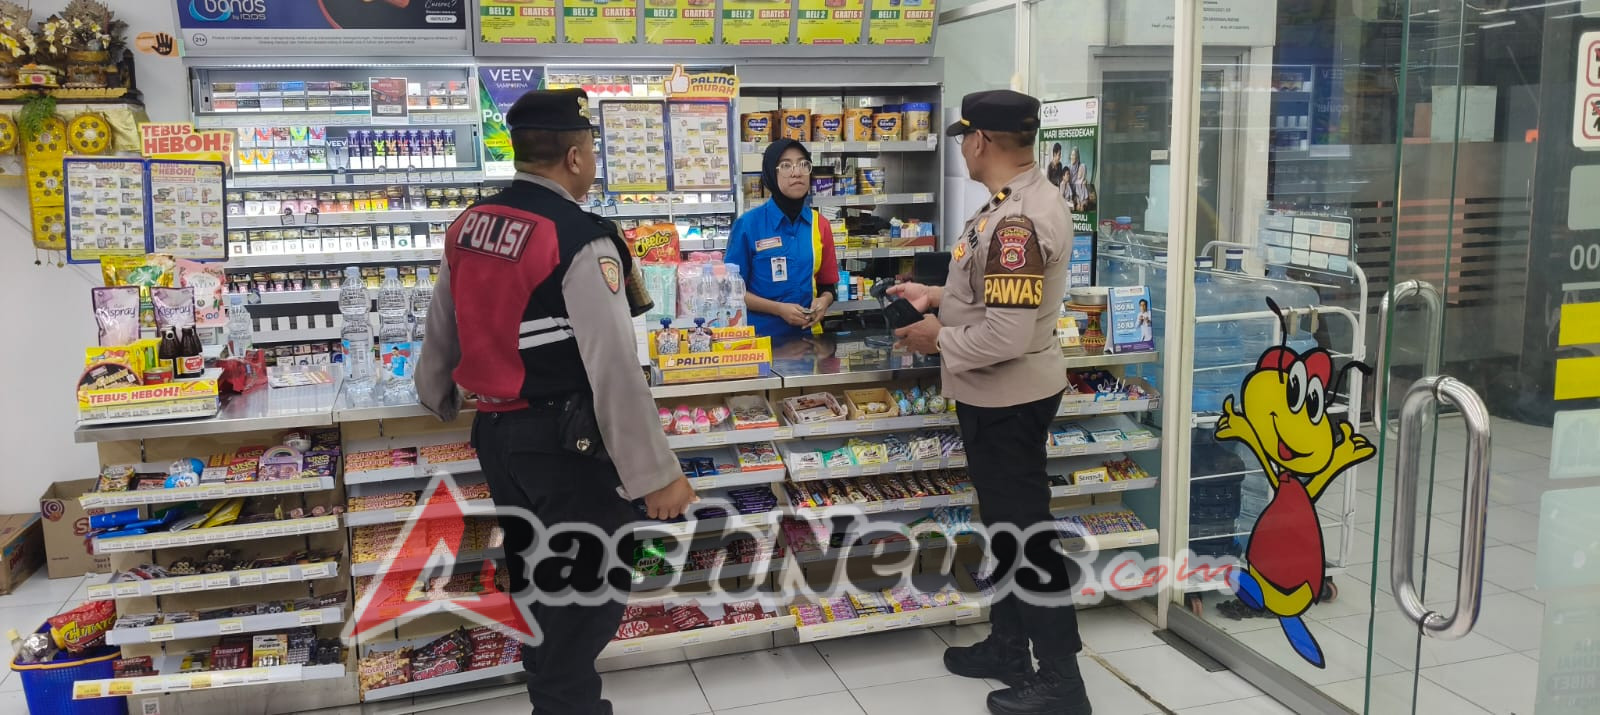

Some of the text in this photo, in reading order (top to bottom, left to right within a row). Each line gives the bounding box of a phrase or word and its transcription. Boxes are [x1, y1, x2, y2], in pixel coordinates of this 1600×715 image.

[489, 7, 504, 16] BELI
[523, 7, 548, 16] GRATIS
[573, 8, 588, 16] BELI
[605, 8, 630, 17] GRATIS
[654, 9, 668, 17] BELI
[684, 9, 708, 18] GRATIS
[731, 10, 746, 18] BELI
[761, 10, 784, 18] GRATIS
[806, 10, 820, 18] BELI
[834, 10, 858, 19] GRATIS
[878, 10, 892, 19] BELI
[906, 10, 929, 19] GRATIS
[489, 69, 534, 81] VEEV
[690, 76, 735, 86] PALING
[692, 84, 735, 95] MURAH
[142, 125, 190, 137] TEBUS
[1044, 128, 1094, 139] MARI BERSEDEKAH
[144, 132, 231, 154] HEBOH!
[457, 212, 530, 258] POLISI
[634, 231, 672, 258] Cheetos
[984, 278, 1043, 304] PAWAS
[676, 352, 765, 366] PALING MURAH
[90, 387, 180, 404] TEBUS HEBOH!
[231, 460, 257, 472] UNO
[618, 622, 648, 638] KitKat
[215, 647, 244, 655] EVEREADY
